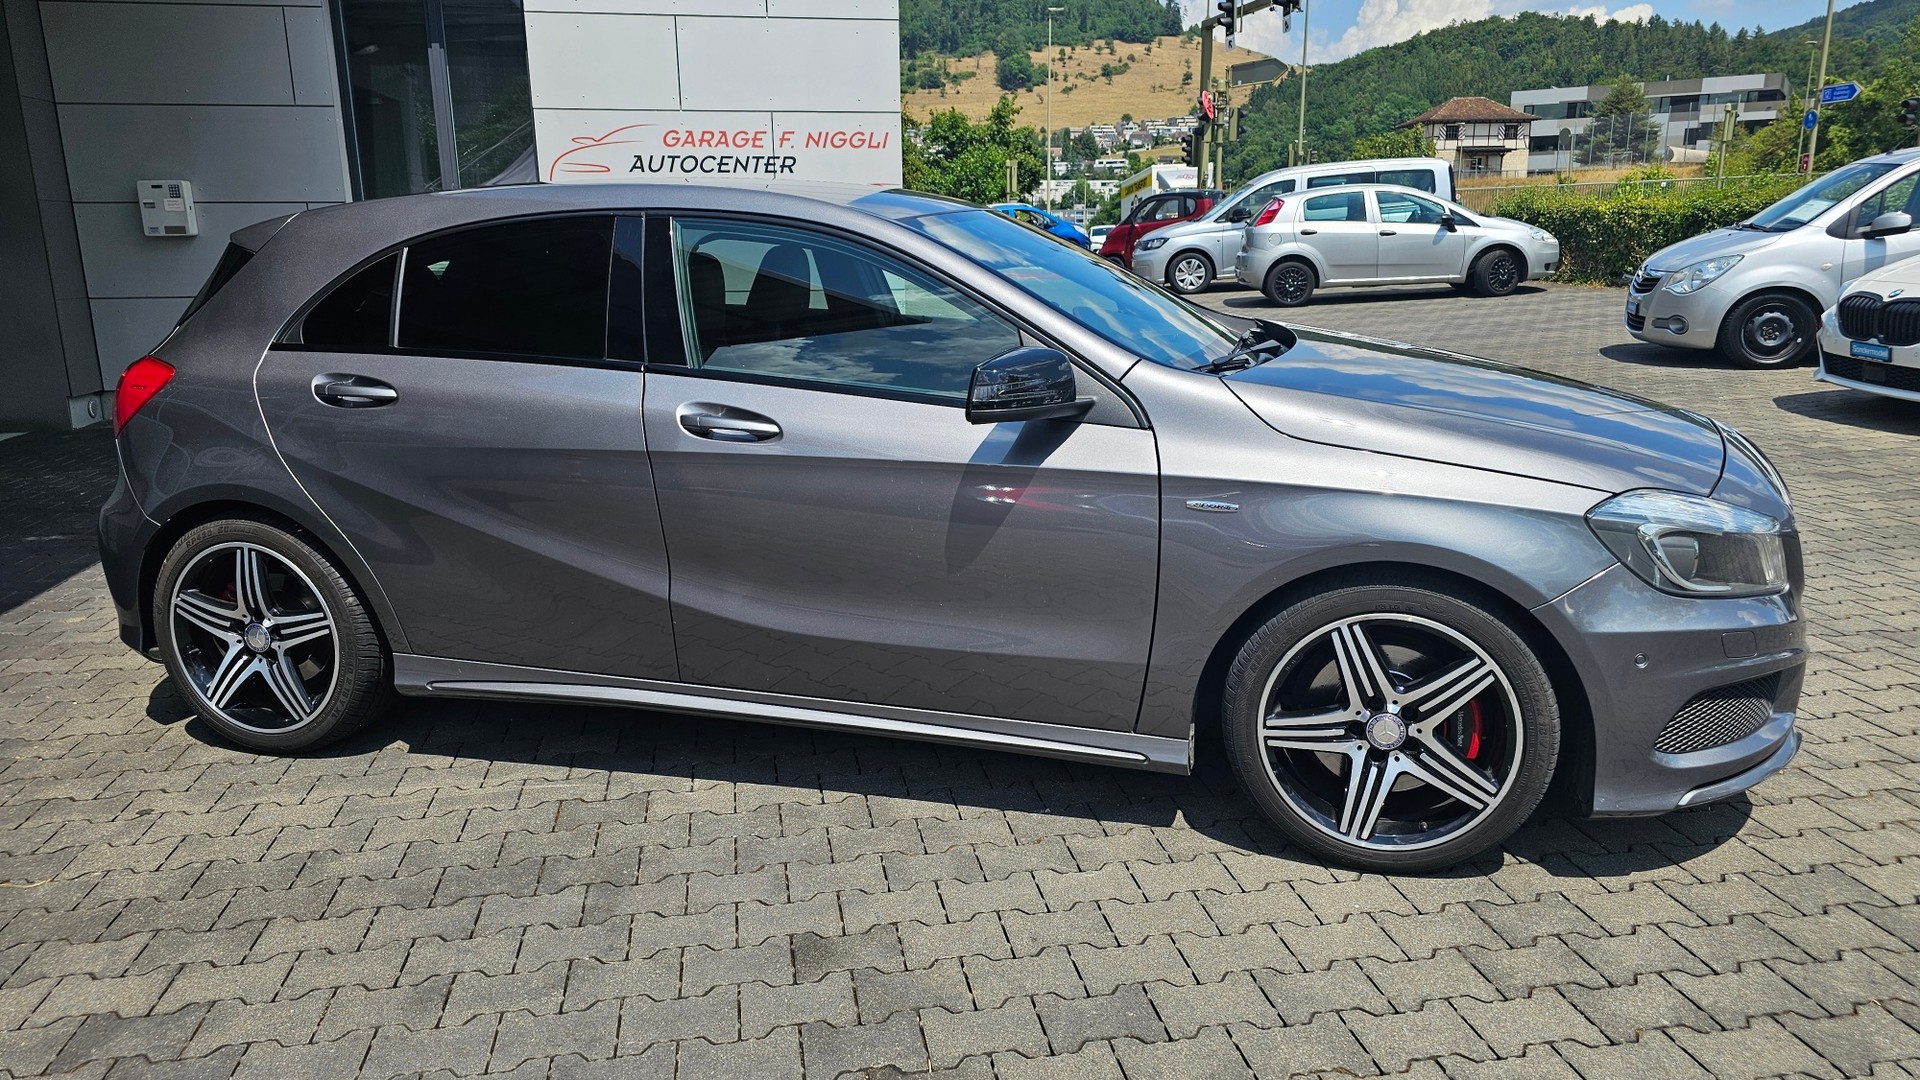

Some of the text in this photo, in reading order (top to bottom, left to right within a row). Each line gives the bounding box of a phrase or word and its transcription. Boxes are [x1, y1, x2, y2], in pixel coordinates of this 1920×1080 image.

[662, 129, 889, 149] GARAGE F. NIGGLI
[629, 155, 797, 174] AUTOCENTER
